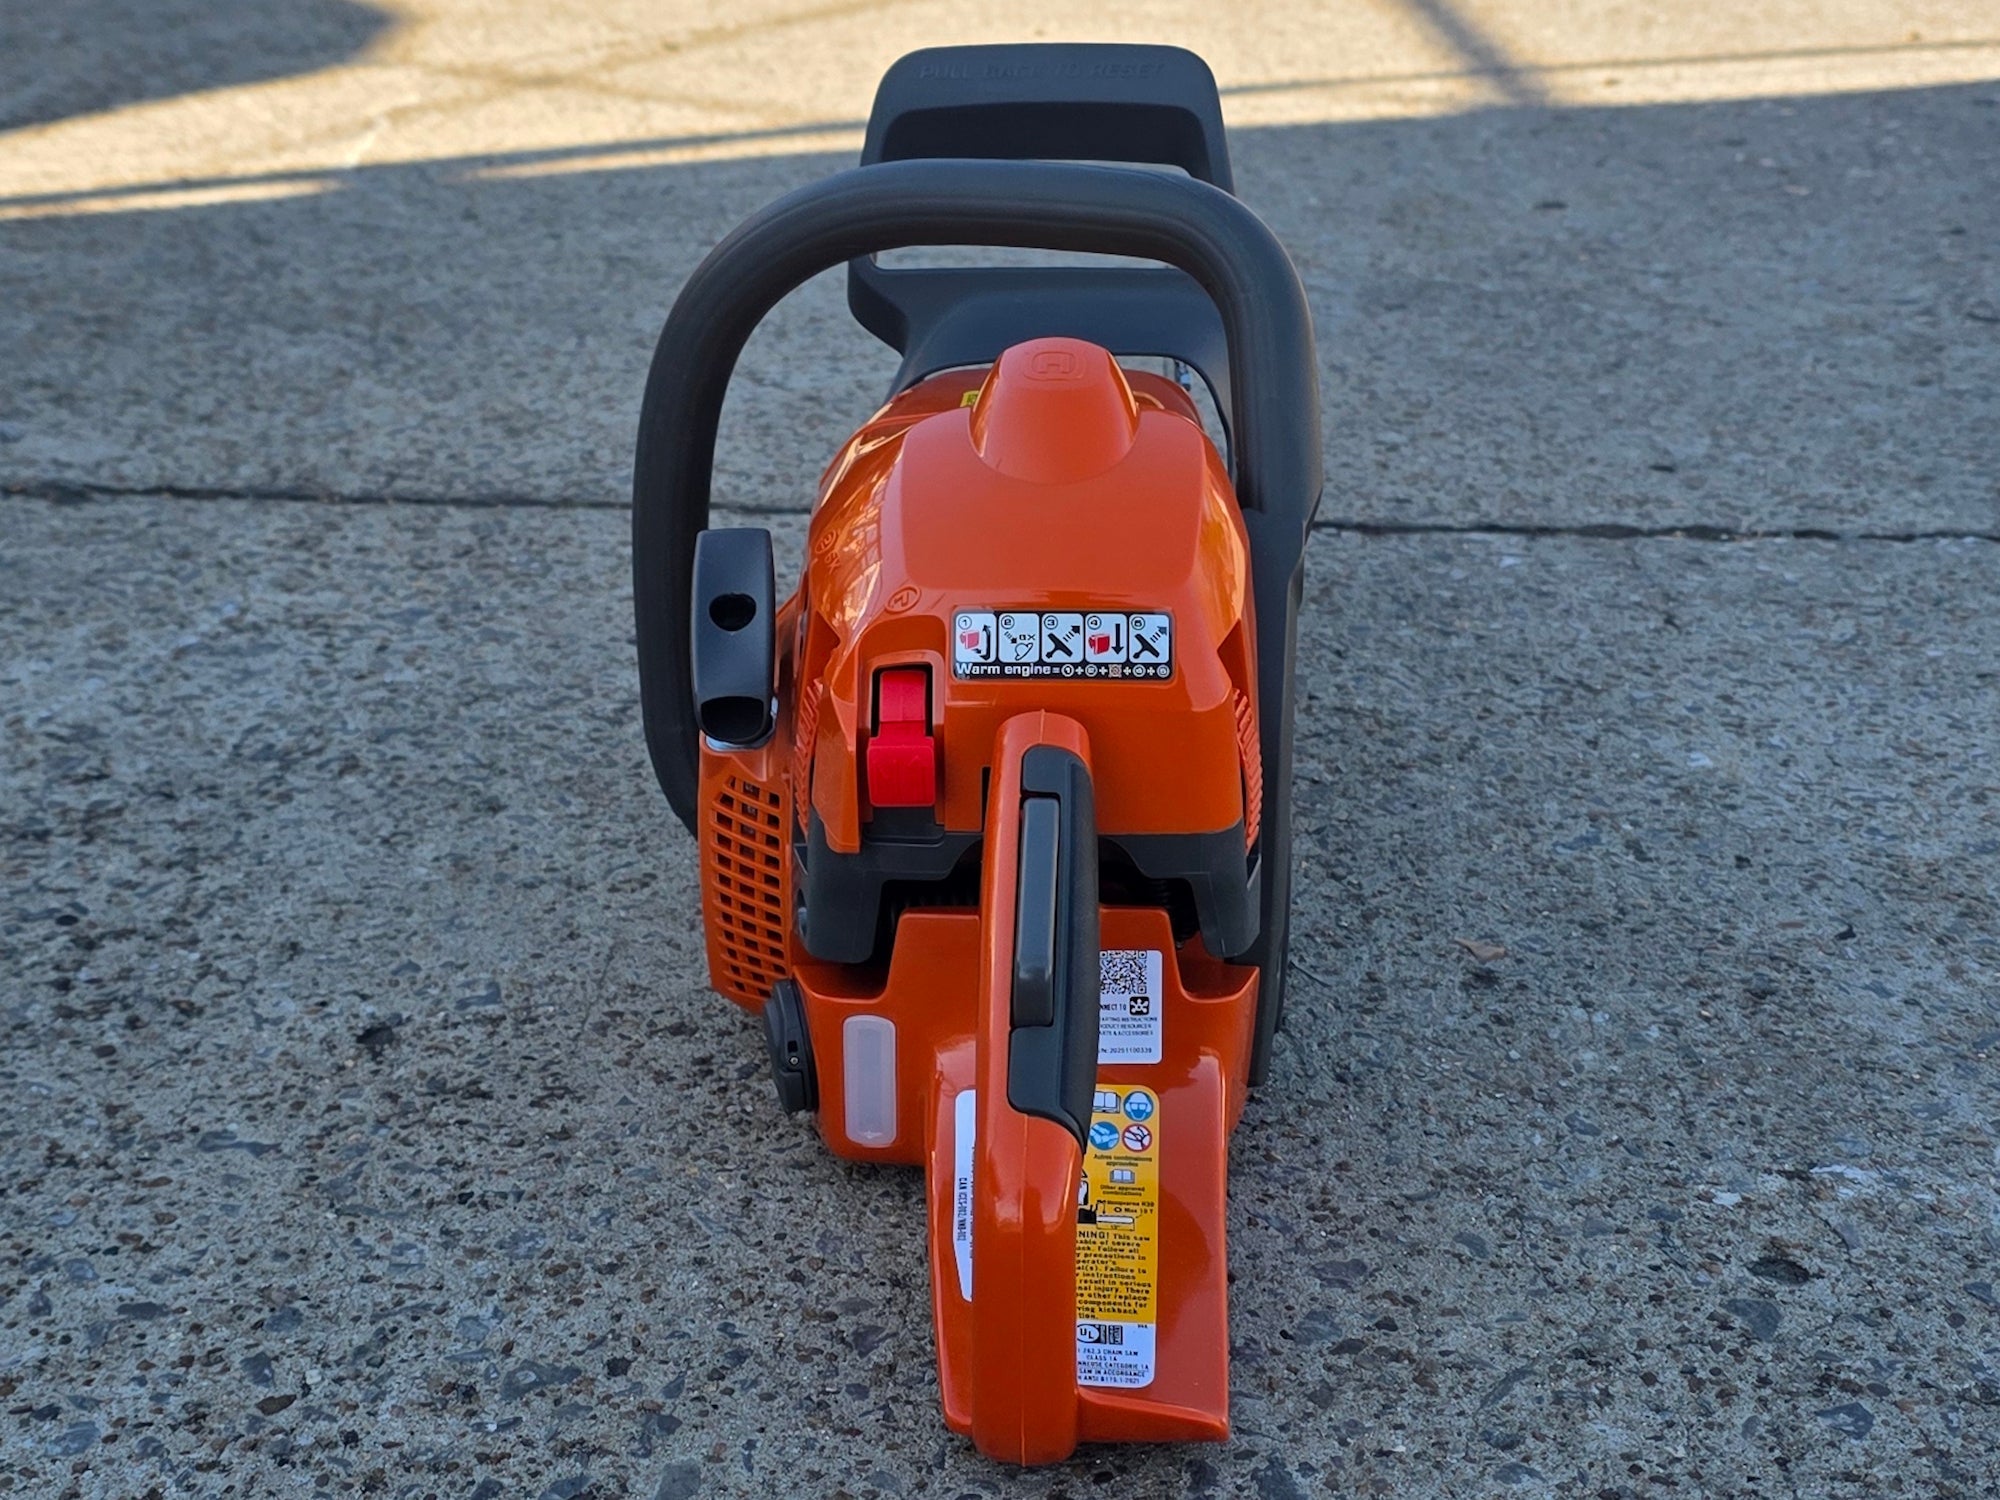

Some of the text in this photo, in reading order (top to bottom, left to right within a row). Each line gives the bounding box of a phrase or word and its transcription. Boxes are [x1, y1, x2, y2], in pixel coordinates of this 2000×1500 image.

[956, 662, 1000, 675] Warm
[959, 1177, 967, 1190] CAN
[1083, 1272, 1136, 1280] instructions
[1078, 1299, 1132, 1307] components
[1098, 1307, 1138, 1315] kickback
[1080, 1328, 1094, 1339] UL
